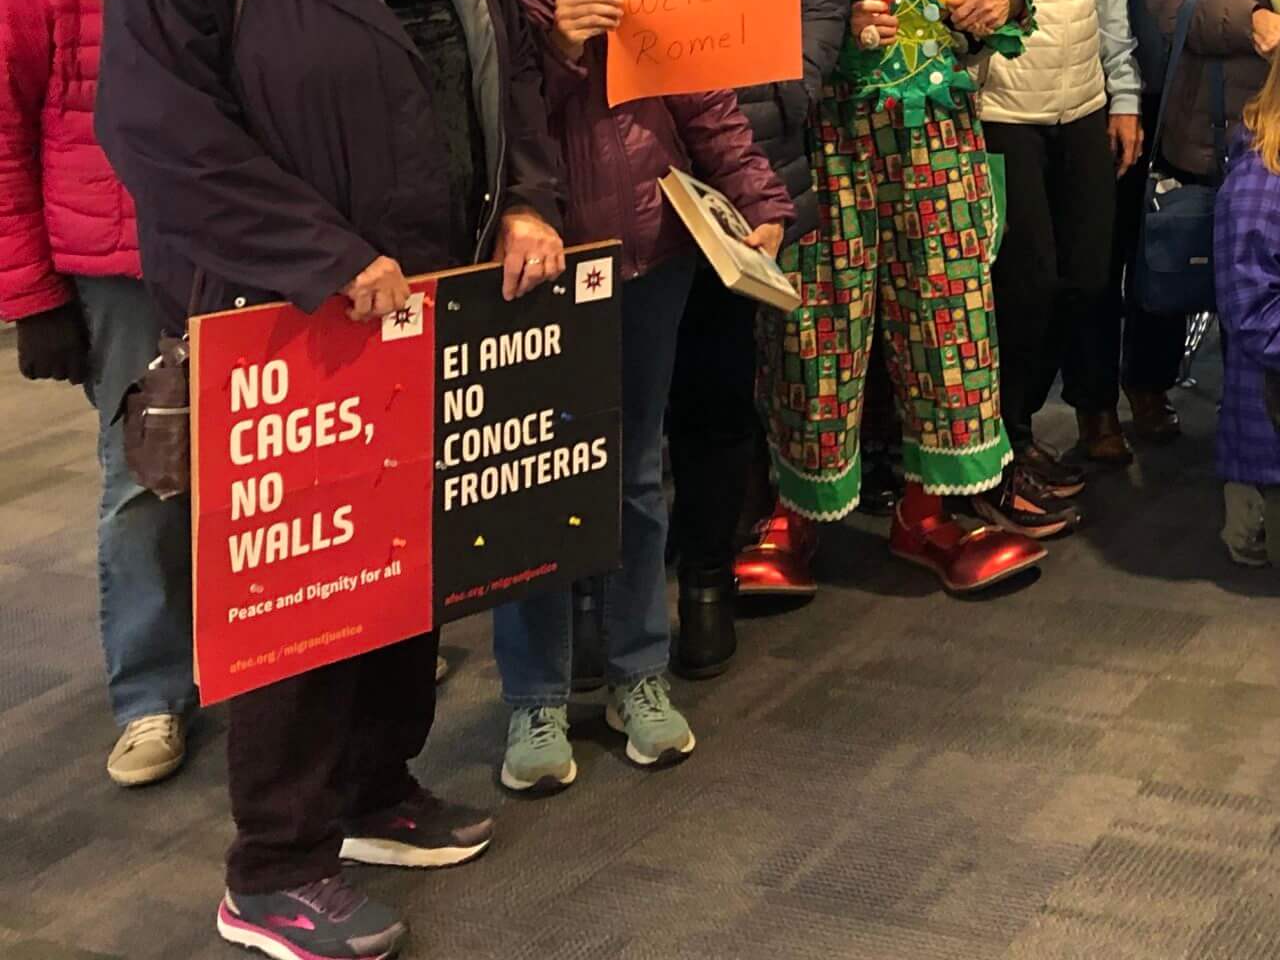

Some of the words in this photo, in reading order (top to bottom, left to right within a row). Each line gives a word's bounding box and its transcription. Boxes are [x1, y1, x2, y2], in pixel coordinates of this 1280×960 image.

[633, 13, 746, 65] Romel
[480, 323, 562, 372] AMOR
[230, 358, 289, 413] NO
[444, 383, 485, 424] NO
[230, 396, 375, 466] CAGES,
[443, 408, 555, 467] CONOCE
[231, 471, 284, 521] NO
[444, 437, 609, 512] FRONTERAS
[228, 504, 355, 574] WALLS
[228, 596, 272, 624] Peace
[276, 589, 303, 609] and
[307, 574, 357, 600] Dignity
[361, 568, 381, 585] for
[384, 560, 401, 577] all
